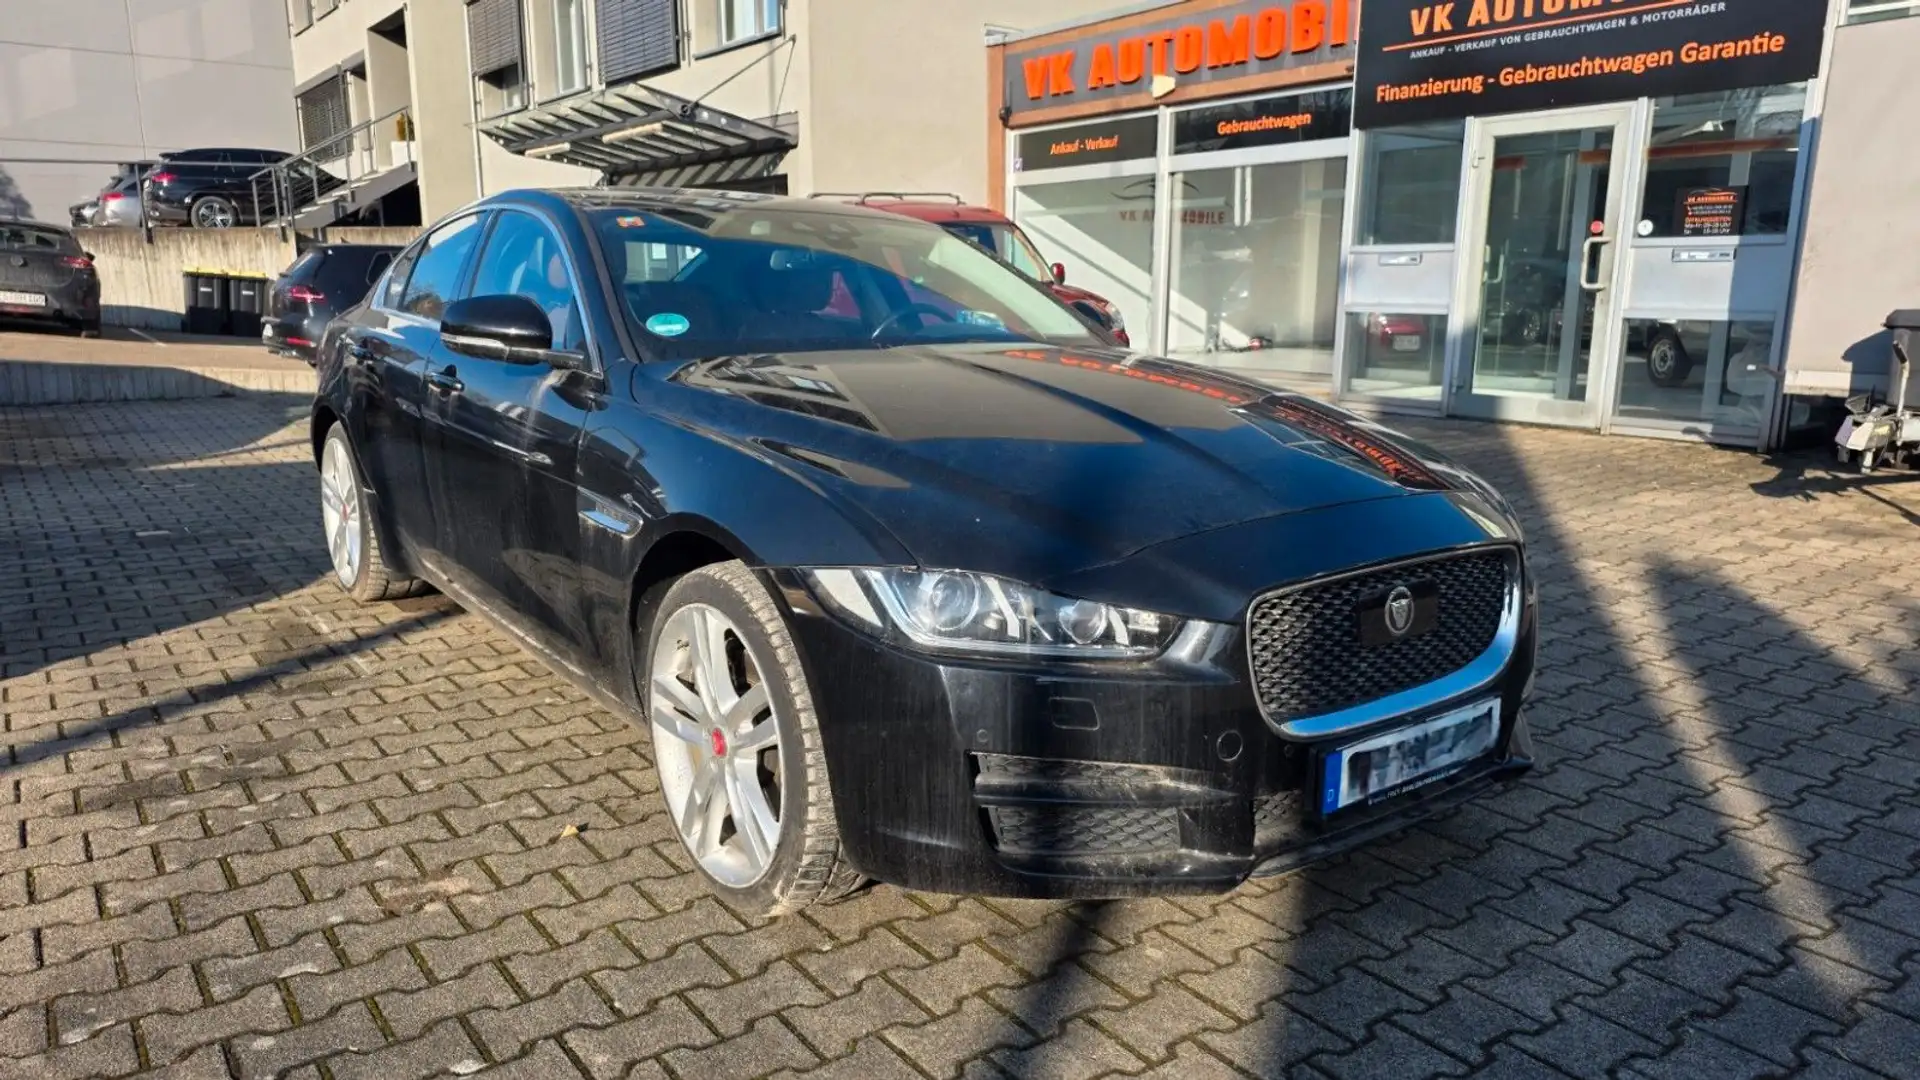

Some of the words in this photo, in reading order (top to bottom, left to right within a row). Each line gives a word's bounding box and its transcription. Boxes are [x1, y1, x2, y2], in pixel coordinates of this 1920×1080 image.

[1410, 2, 1455, 36] VK
[1410, 47, 1446, 60] ANKAUF
[1453, 38, 1497, 53] VERKAUF
[1500, 35, 1522, 46] VON
[1525, 18, 1627, 42] GEBRAUCHTWAGEN
[1630, 16, 1639, 26] &
[1642, 2, 1727, 24] MOTORRÄDER
[1023, 50, 1076, 99] VK
[1088, 0, 1357, 90] AUTOMOBI
[1376, 73, 1485, 102] Finanzierung
[1499, 49, 1674, 86] Gebrauchtwagen
[1680, 31, 1786, 63] Garantie
[1217, 112, 1312, 135] Gebrauchtwagen
[1050, 138, 1079, 155] Ankauf
[1085, 134, 1119, 151] Verkauf
[1327, 789, 1335, 803] D
